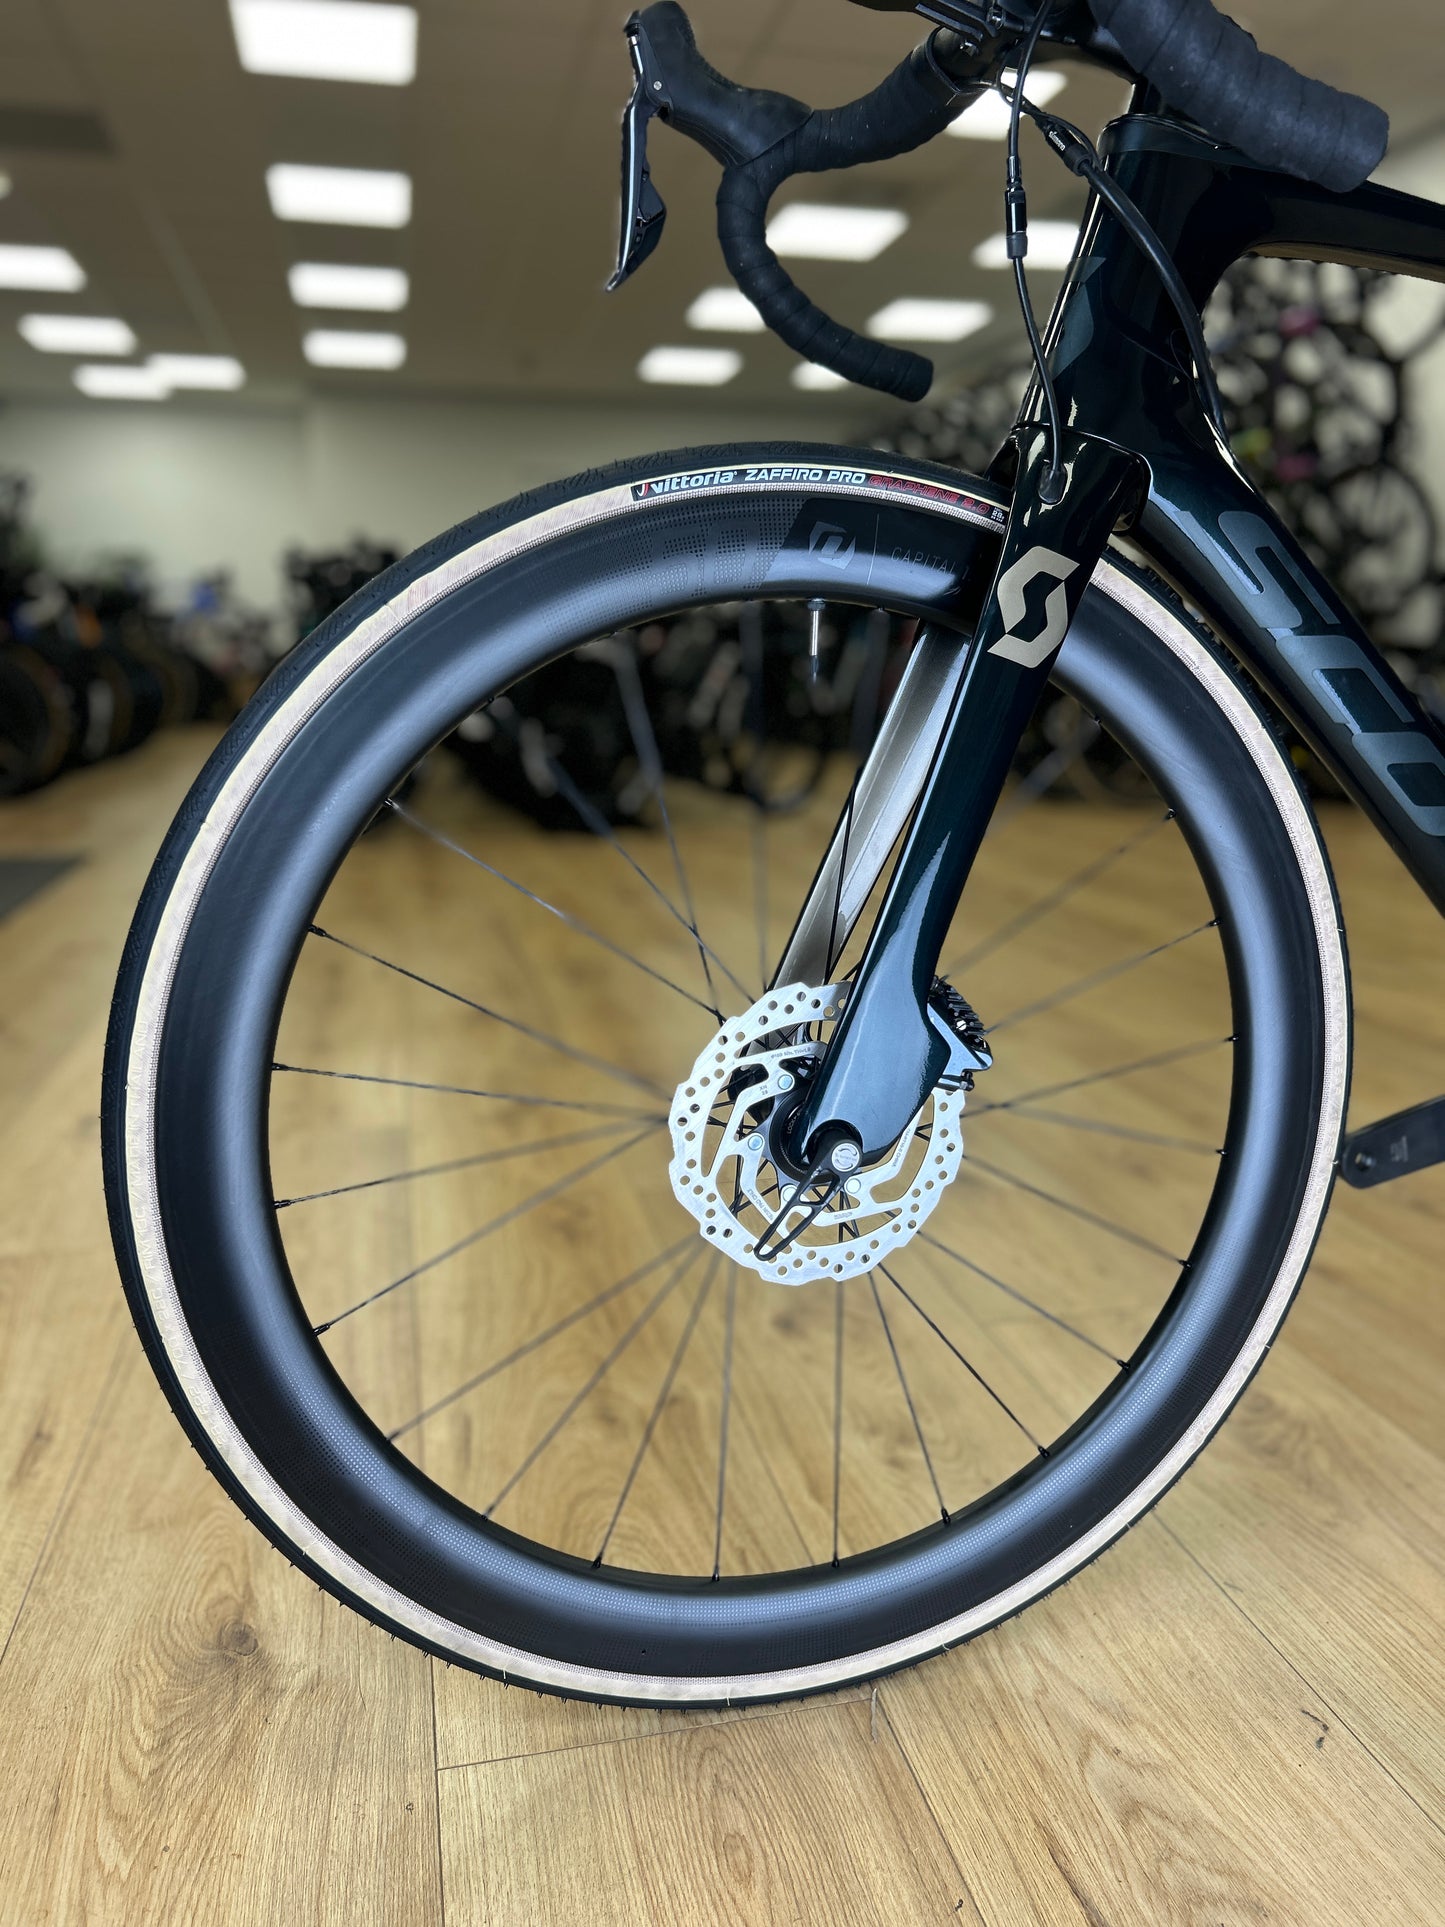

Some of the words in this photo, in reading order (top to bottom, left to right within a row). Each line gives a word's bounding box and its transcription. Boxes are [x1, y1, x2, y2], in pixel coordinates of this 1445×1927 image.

[651, 471, 734, 494] vittoria
[744, 468, 823, 481] ZAFFIRO
[826, 470, 866, 484] PRO
[868, 475, 960, 503] GRAPHENE
[961, 498, 990, 514] 2.0
[129, 1020, 148, 1105] THAILAND
